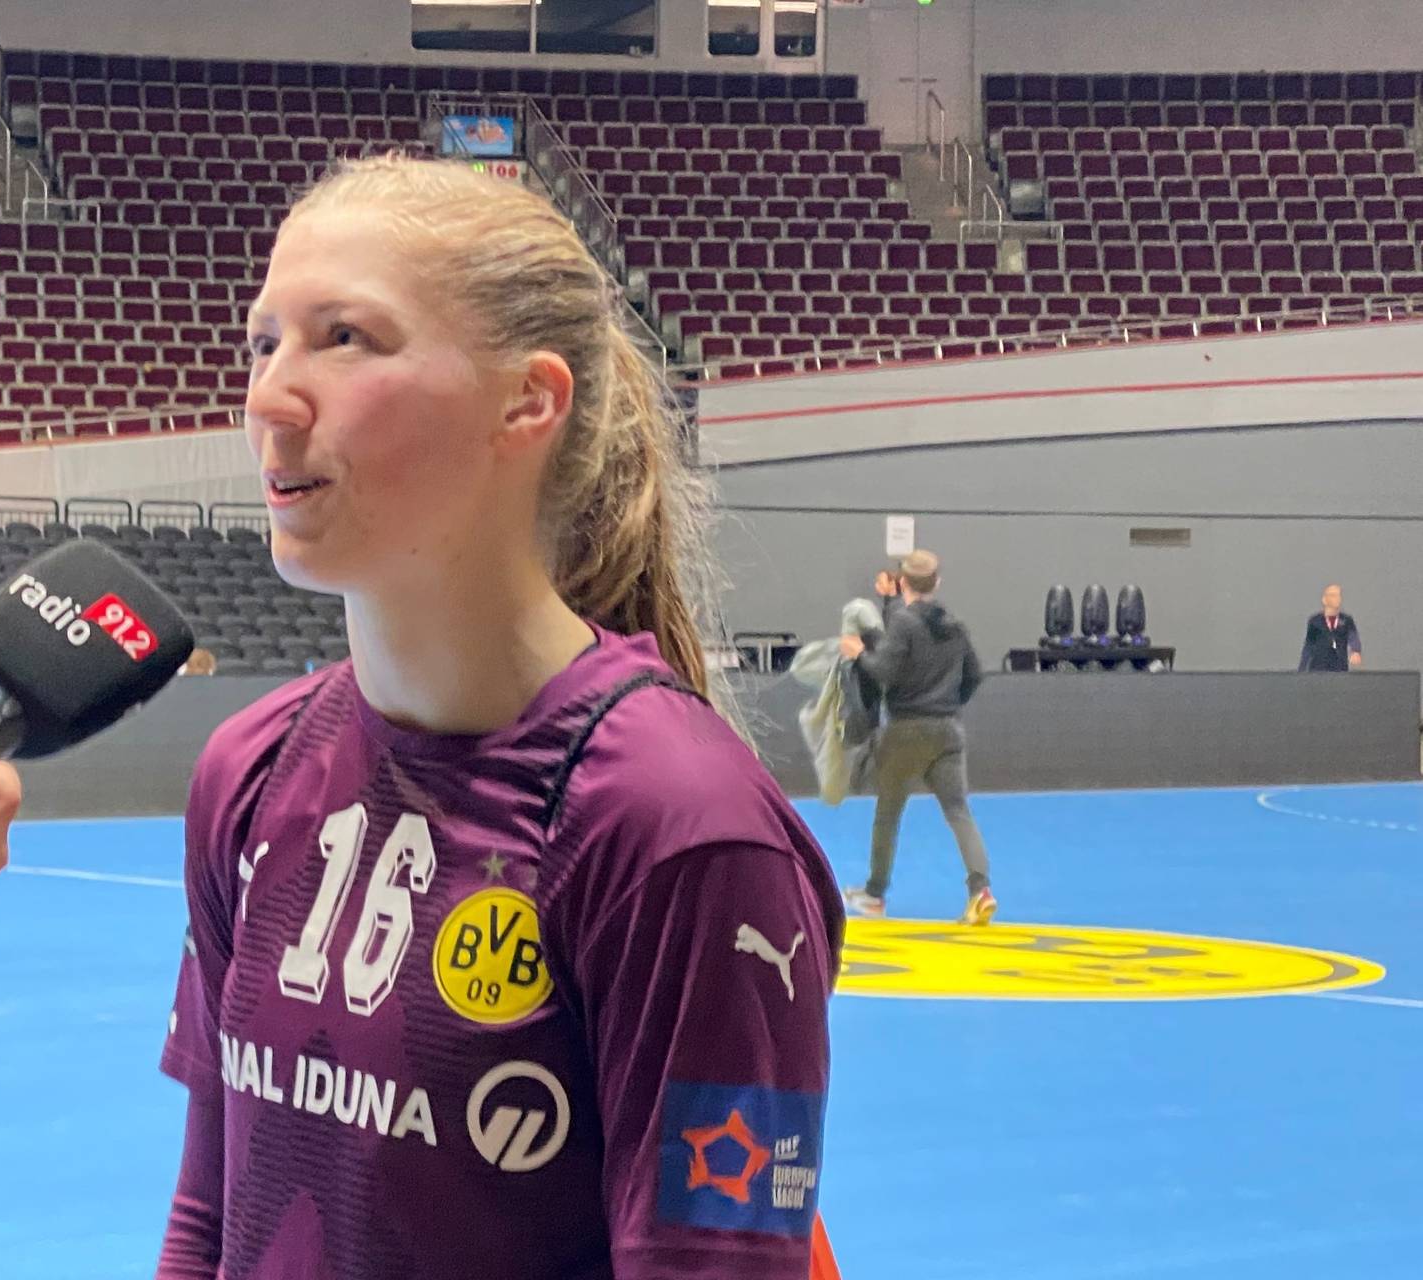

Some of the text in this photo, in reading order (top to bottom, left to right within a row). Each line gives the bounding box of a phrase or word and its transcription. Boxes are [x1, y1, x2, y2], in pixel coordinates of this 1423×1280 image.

[9, 574, 151, 660] radio 91.2
[278, 802, 437, 1017] 16
[450, 904, 543, 987] BVB
[467, 979, 502, 1006] 09
[220, 1028, 438, 1147] NAL IDUNA
